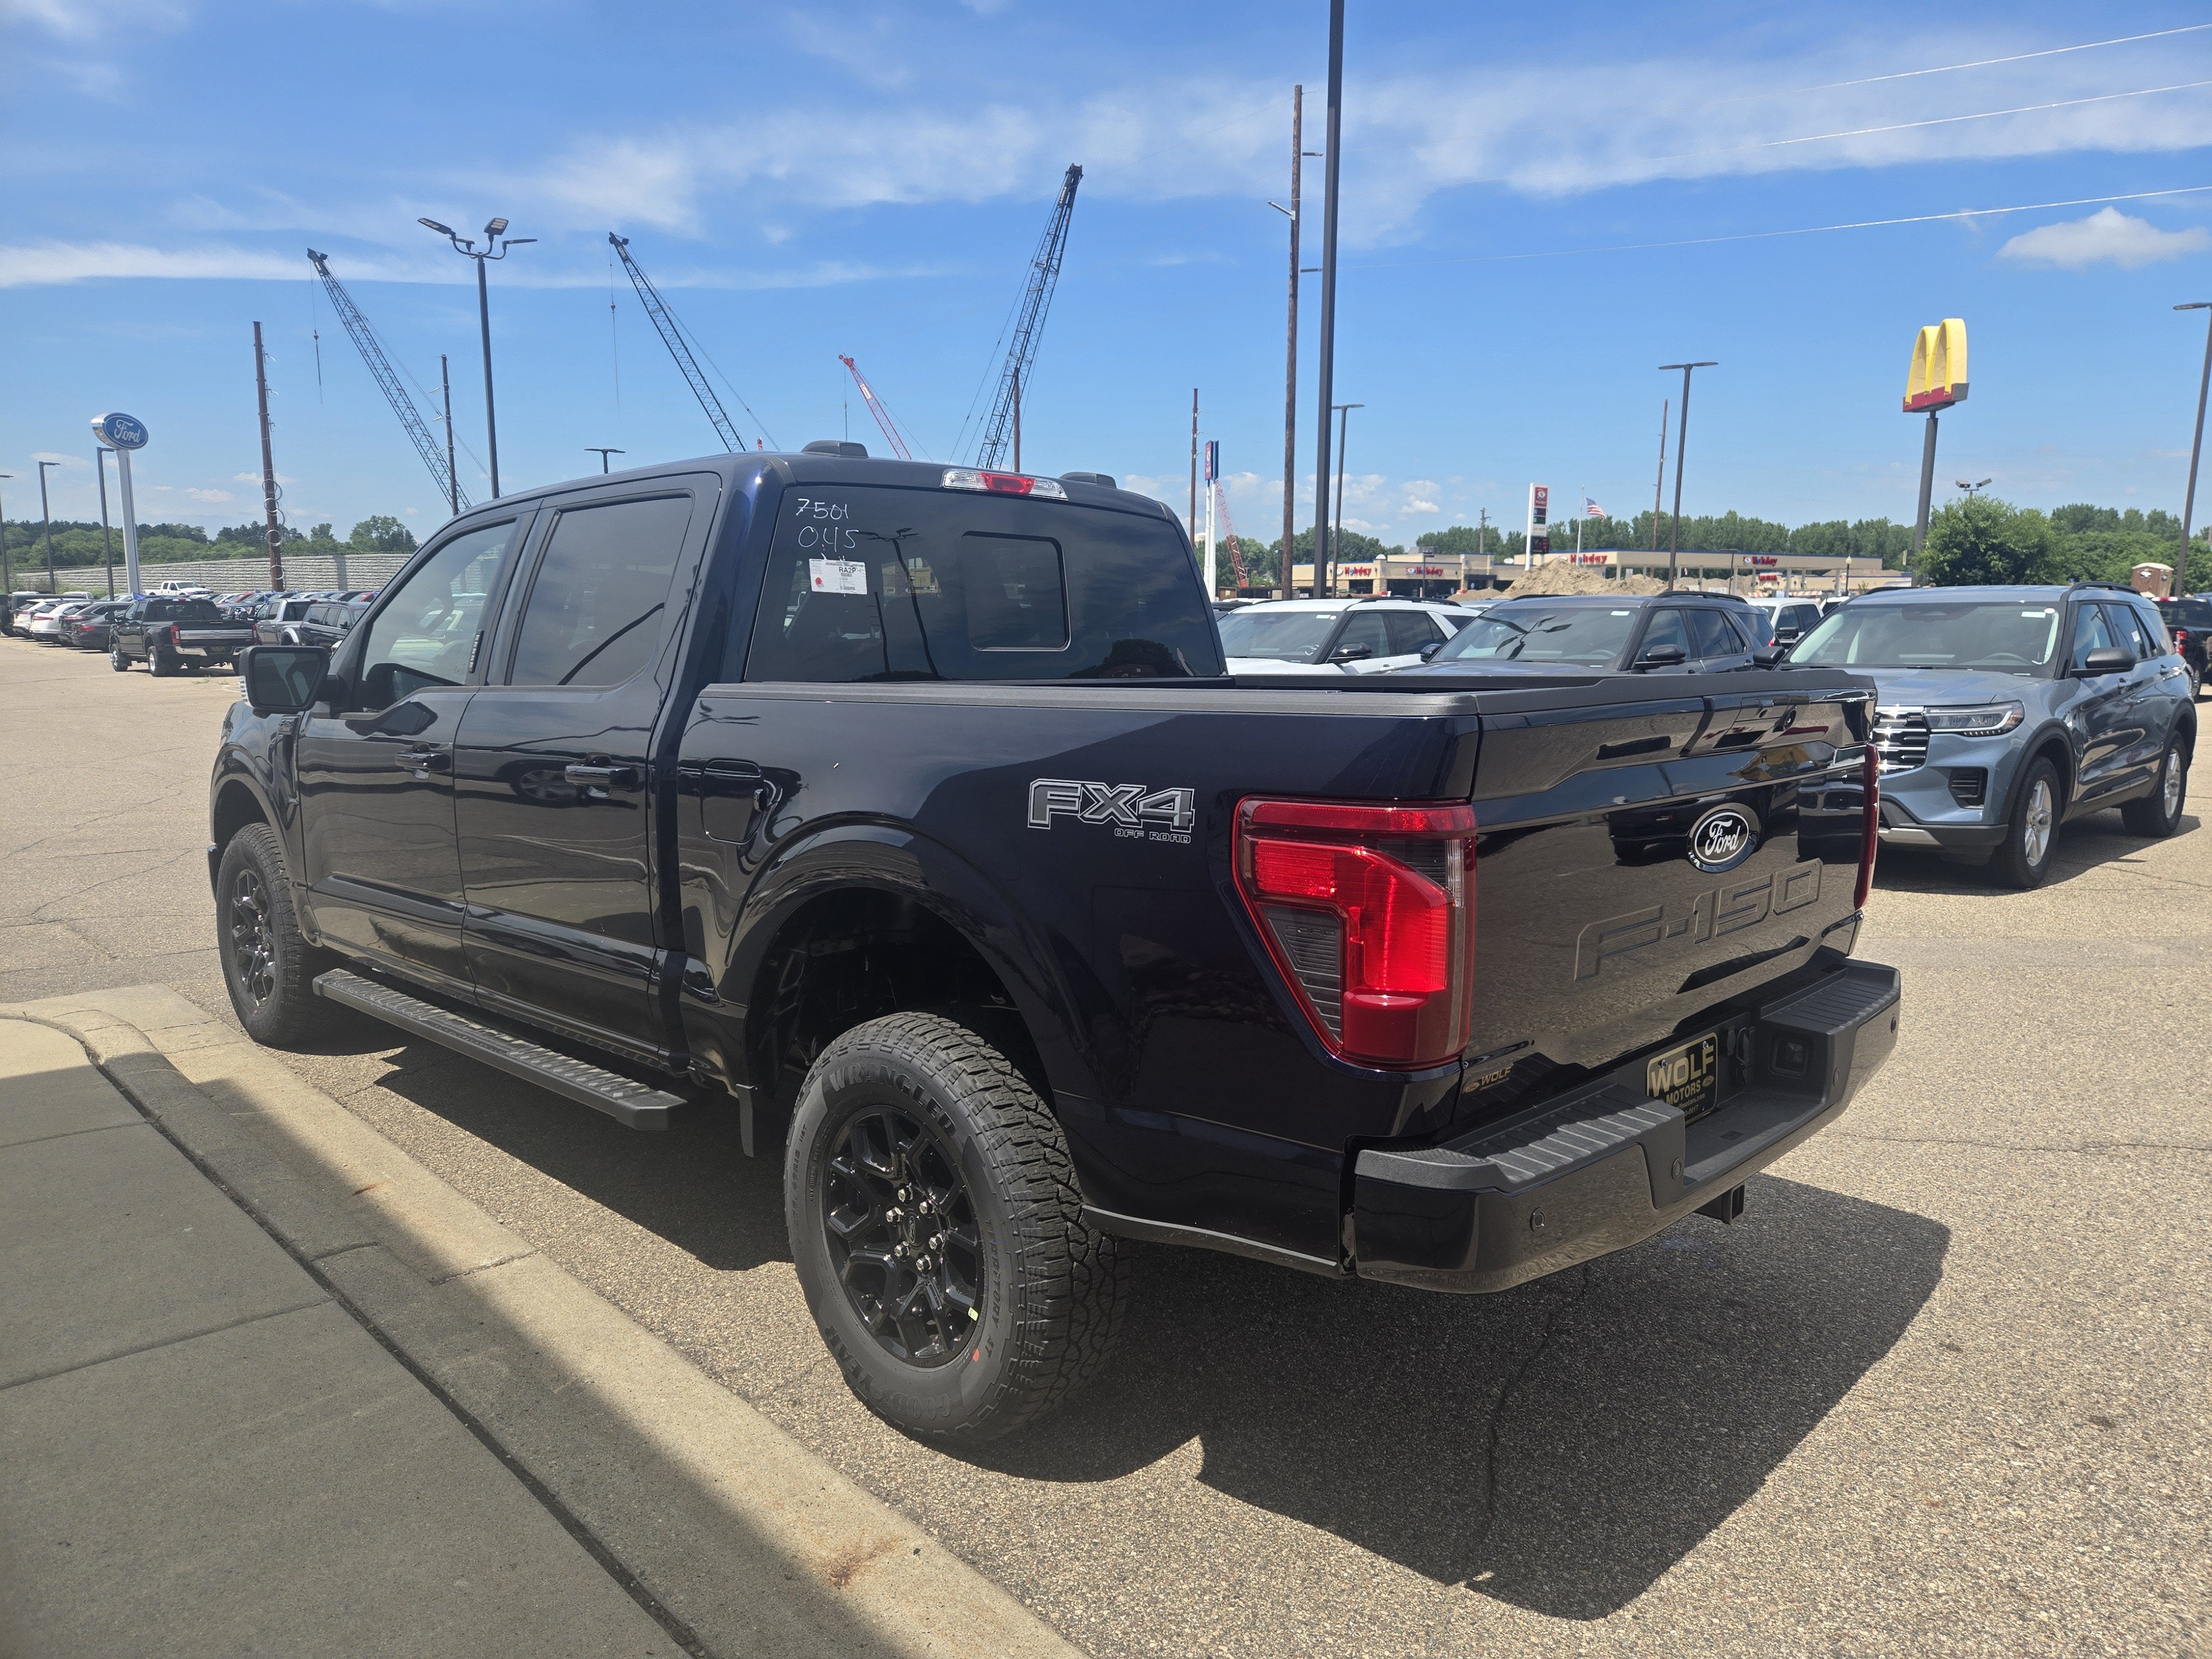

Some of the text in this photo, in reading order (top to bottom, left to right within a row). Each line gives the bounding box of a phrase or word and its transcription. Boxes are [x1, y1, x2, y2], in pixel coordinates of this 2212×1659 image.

[114, 419, 140, 443] Ford
[1027, 778, 1195, 833] FX4
[1114, 828, 1191, 844] OFF ROAD
[1704, 819, 1741, 856] Ford
[1573, 858, 1824, 982] F-150
[1481, 1066, 1512, 1086] WOLF
[1651, 1045, 1714, 1098] WOLF
[1666, 1079, 1701, 1105] MOTORS
[829, 1063, 957, 1136] WRANGLER
[824, 1324, 952, 1420] GOODYEAR
